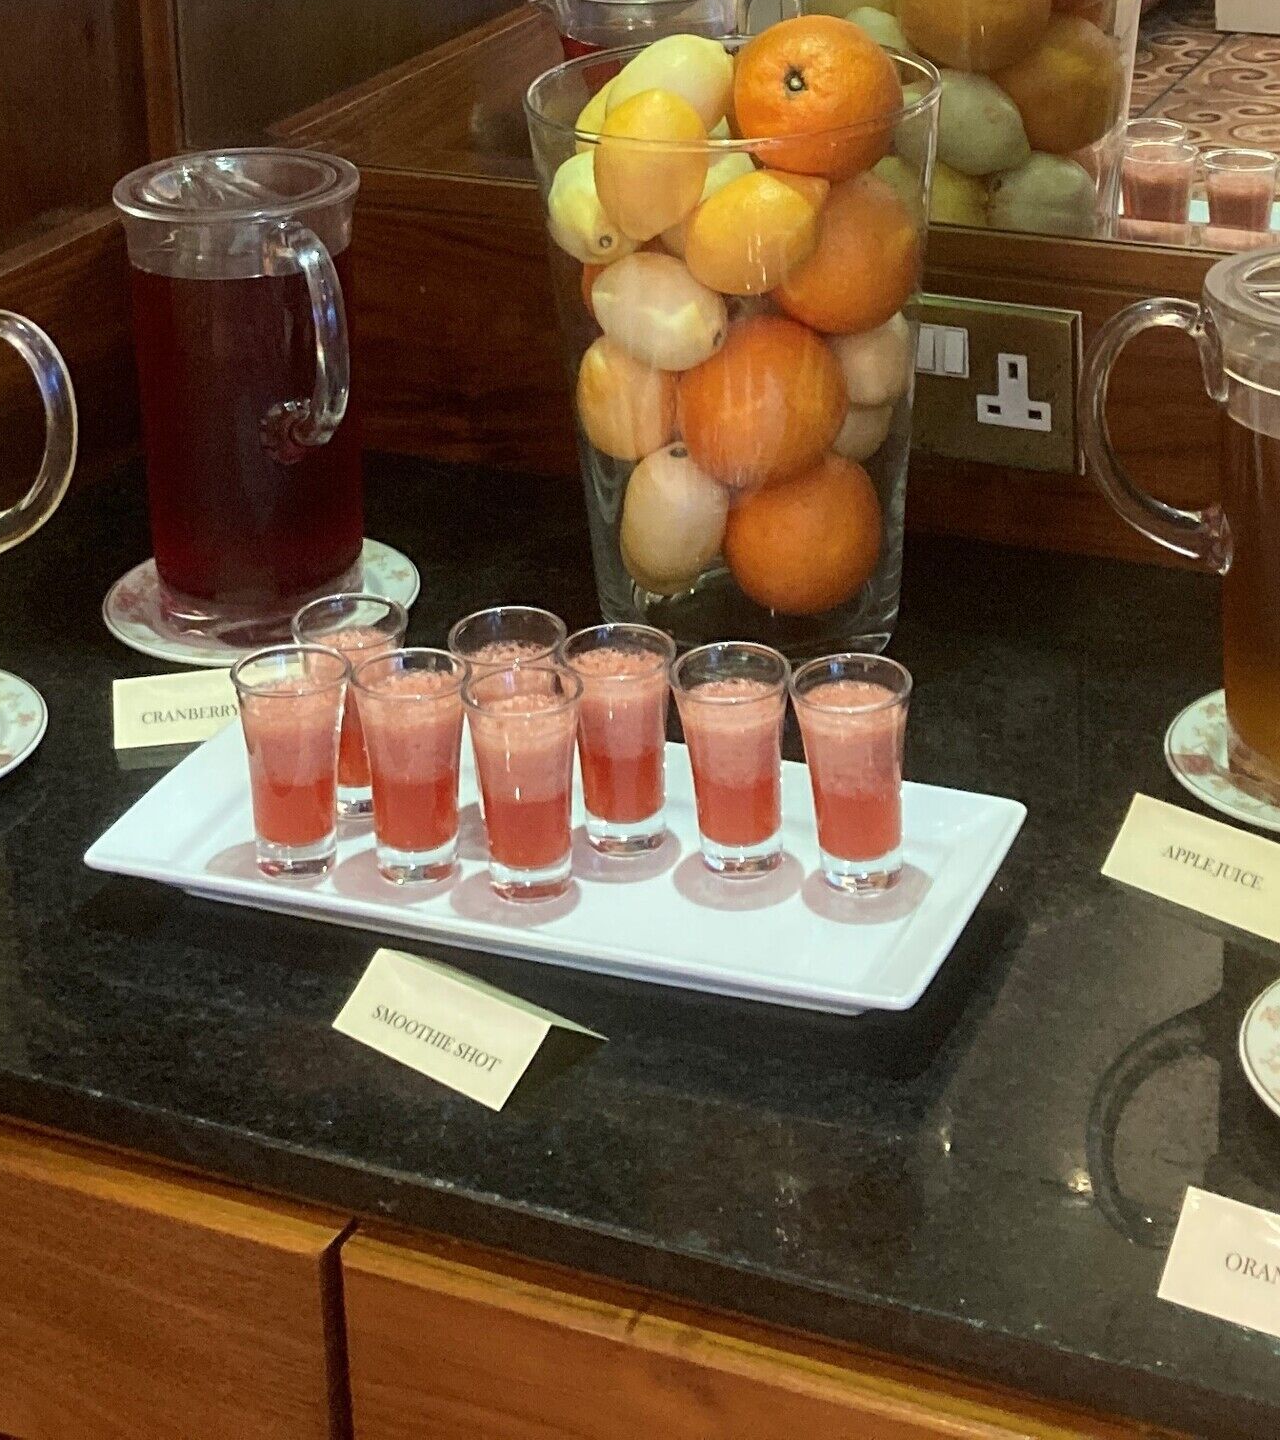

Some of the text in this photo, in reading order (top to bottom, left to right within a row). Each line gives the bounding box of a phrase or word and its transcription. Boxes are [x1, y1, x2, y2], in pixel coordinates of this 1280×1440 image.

[141, 703, 238, 725] CRANBERRY
[1162, 845, 1264, 890] APPLE JUICE
[372, 1004, 502, 1072] SMOOTHIE SHOT
